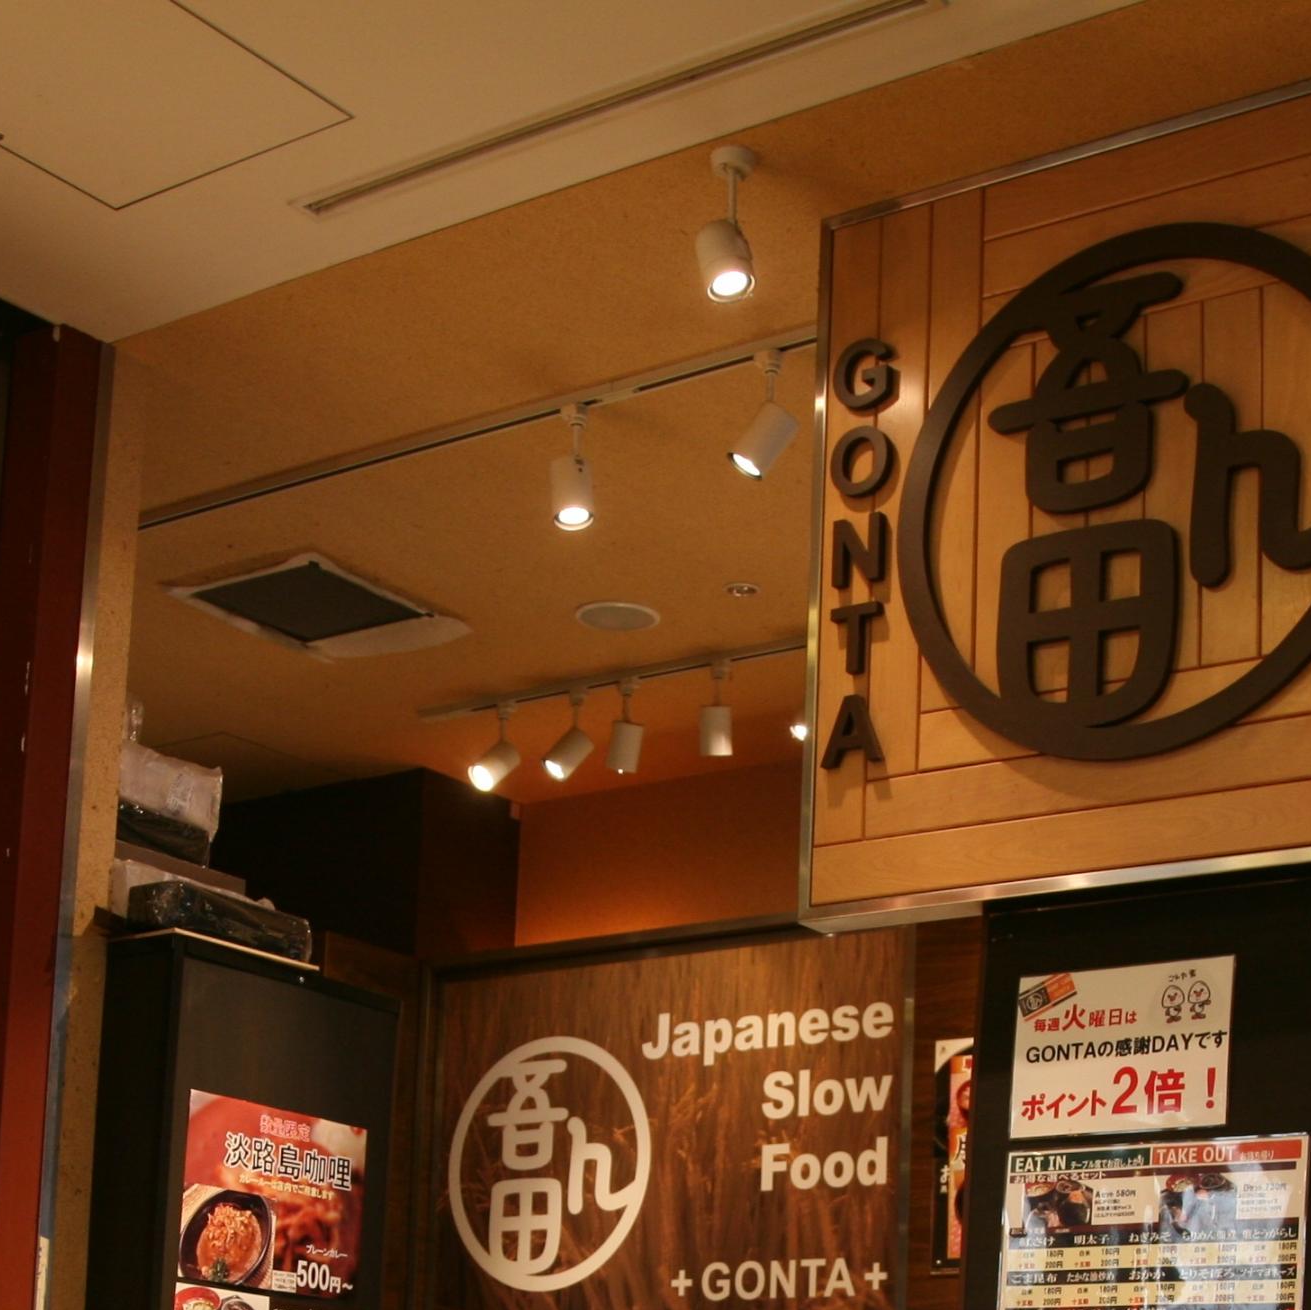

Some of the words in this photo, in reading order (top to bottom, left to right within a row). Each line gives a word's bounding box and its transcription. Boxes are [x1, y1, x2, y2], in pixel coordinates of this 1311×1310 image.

[820, 337, 900, 770] GONTA
[642, 1001, 894, 1066] Japanese
[1033, 1004, 1138, 1033] 毎週火曜日は
[1026, 1030, 1228, 1063] GONTAの感謝DAYです
[762, 1069, 893, 1120] Slow
[760, 1137, 888, 1191] Food
[1015, 1156, 1044, 1175] EAT
[1048, 1155, 1066, 1172] IN
[1157, 1147, 1199, 1165] TAKE
[1202, 1145, 1237, 1165] OUT
